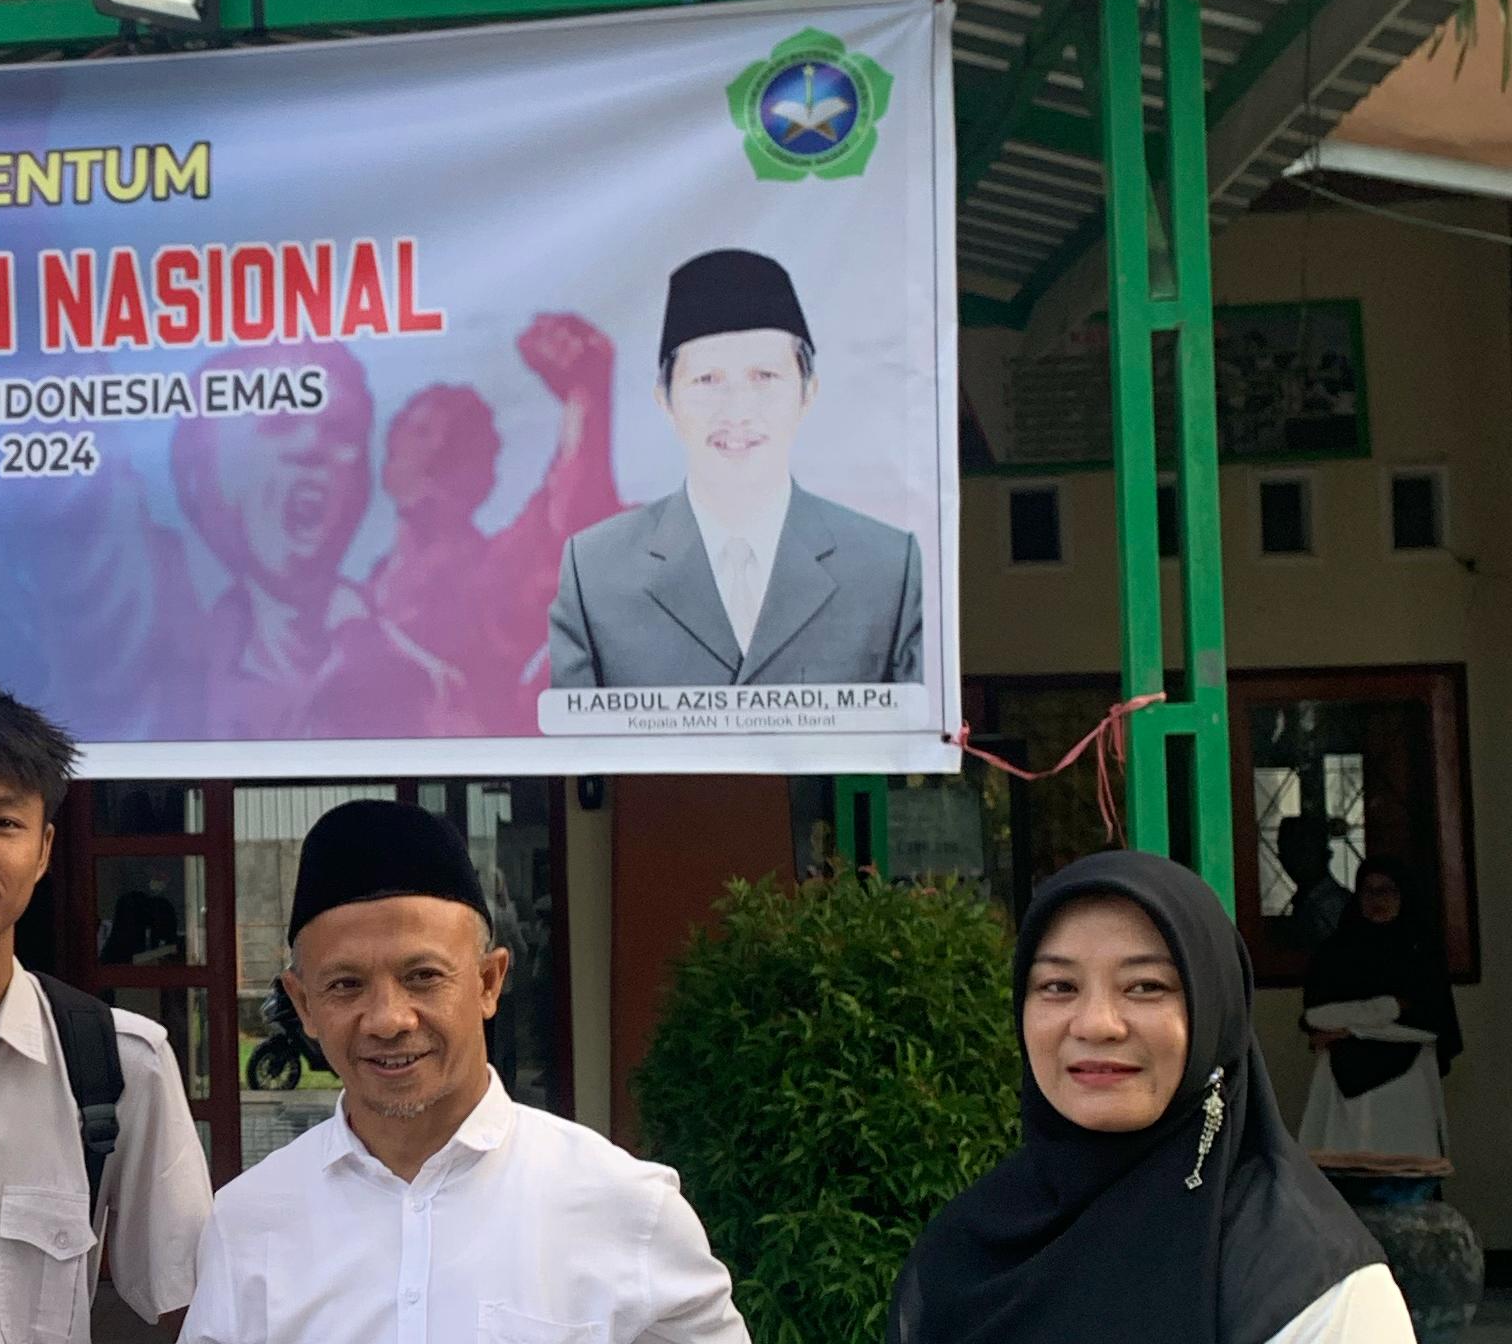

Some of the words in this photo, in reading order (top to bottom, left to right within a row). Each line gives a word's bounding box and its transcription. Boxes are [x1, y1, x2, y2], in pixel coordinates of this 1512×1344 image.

[40, 239, 445, 349] NASIONAL
[207, 371, 323, 413] EMAS
[3, 436, 96, 473] 2024
[567, 692, 670, 712] H.ABDUL
[676, 691, 729, 710] AZIS
[736, 690, 829, 711] FARADI,
[837, 688, 899, 708] M.Pd.
[628, 717, 678, 730] Kepala
[682, 716, 719, 729] MAN
[723, 716, 730, 728] 1
[736, 715, 794, 728] Lombok
[798, 713, 836, 727] Barat
